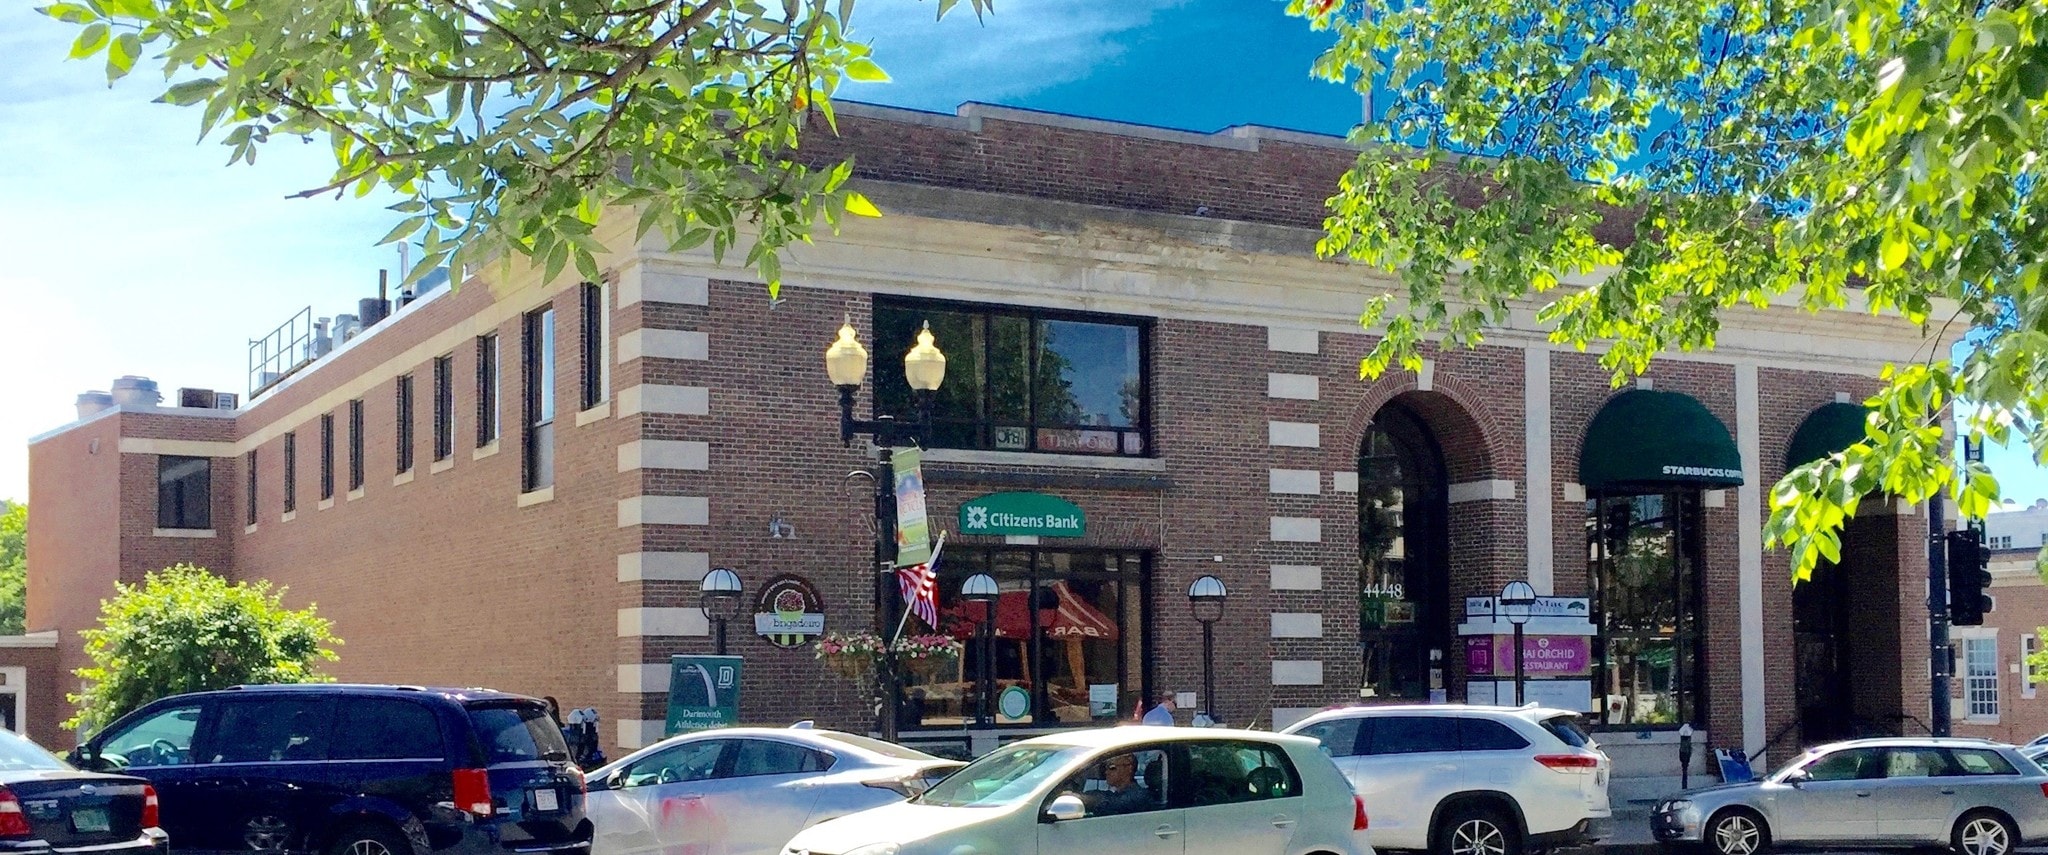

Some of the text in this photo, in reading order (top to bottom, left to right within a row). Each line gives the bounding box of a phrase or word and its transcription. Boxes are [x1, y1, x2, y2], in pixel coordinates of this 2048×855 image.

[1662, 465, 1724, 477] STARBUCKS
[990, 513, 1079, 528] Citizens Bank
[1364, 583, 1403, 598] 44-48
[1537, 649, 1575, 659] ORCHID
[683, 709, 722, 718] Dartmouth
[674, 720, 707, 729] Athletics
